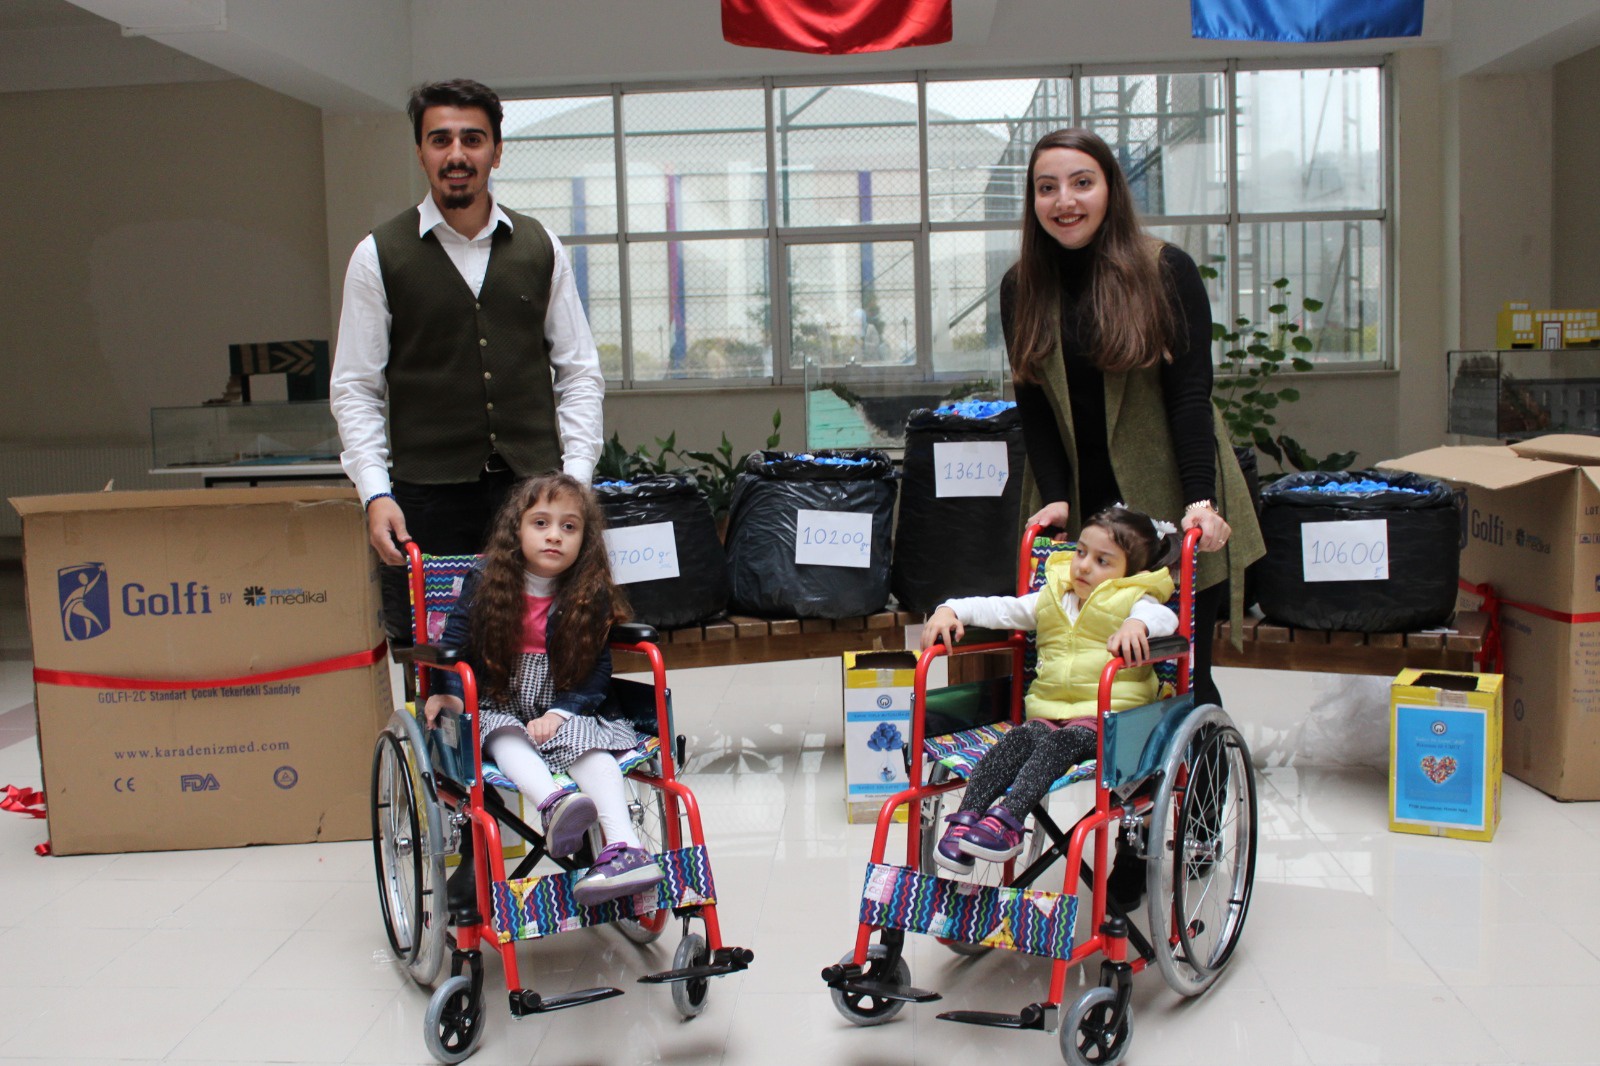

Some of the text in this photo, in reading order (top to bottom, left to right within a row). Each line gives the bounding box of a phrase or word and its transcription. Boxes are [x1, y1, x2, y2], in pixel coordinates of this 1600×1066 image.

[944, 461, 996, 480] 13610
[803, 526, 864, 545] 10200
[1472, 509, 1504, 546] Golfi
[1311, 540, 1385, 565] 10600
[121, 581, 233, 616] Golfi BY
[270, 590, 328, 606] medikal
[98, 684, 301, 704] GOLFI-2C Standart Çocuk Tekerlekli Sandalye
[114, 741, 290, 760] www.karadenizmed.com
[114, 777, 136, 792] CE
[180, 773, 221, 793] FDA
